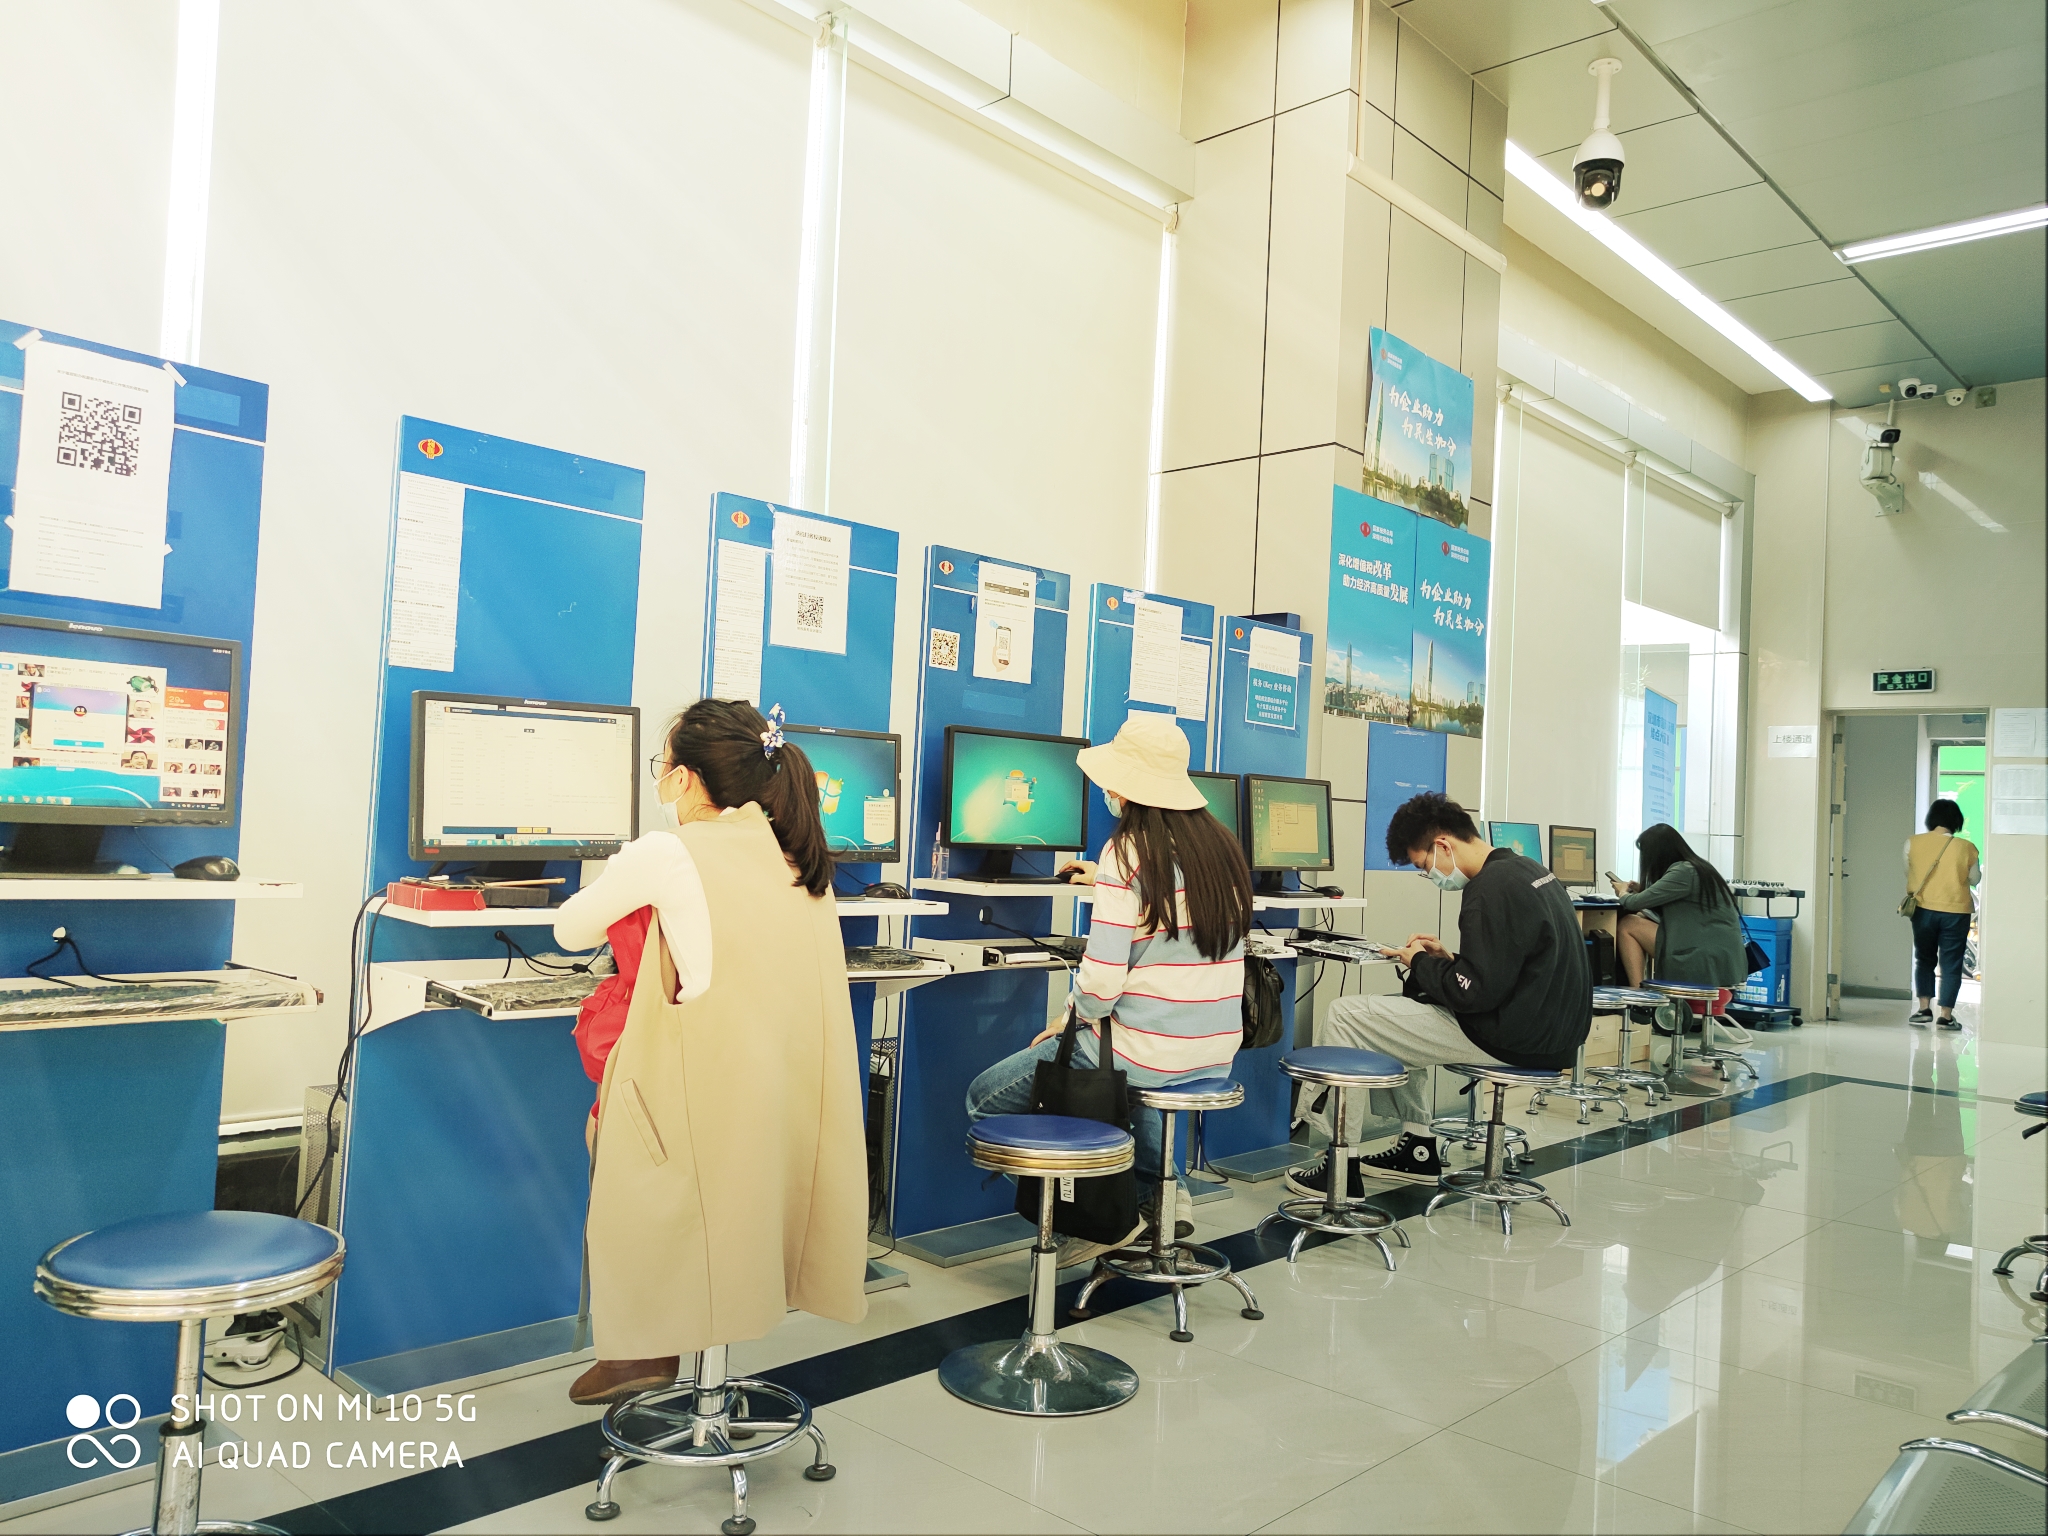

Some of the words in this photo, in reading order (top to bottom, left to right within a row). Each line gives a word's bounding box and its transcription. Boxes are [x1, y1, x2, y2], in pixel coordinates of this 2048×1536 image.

[1388, 384, 1444, 427] 为企业助力
[1401, 416, 1457, 457] 为民生加分
[1338, 552, 1393, 581] 深化增值税改革
[1342, 574, 1409, 605] 助力经济高质量发展
[1420, 578, 1472, 611] 为企业助力
[1432, 606, 1485, 637] 为民生加分
[1877, 672, 1928, 685] 安全出口
[1772, 734, 1812, 744] 上楼通道
